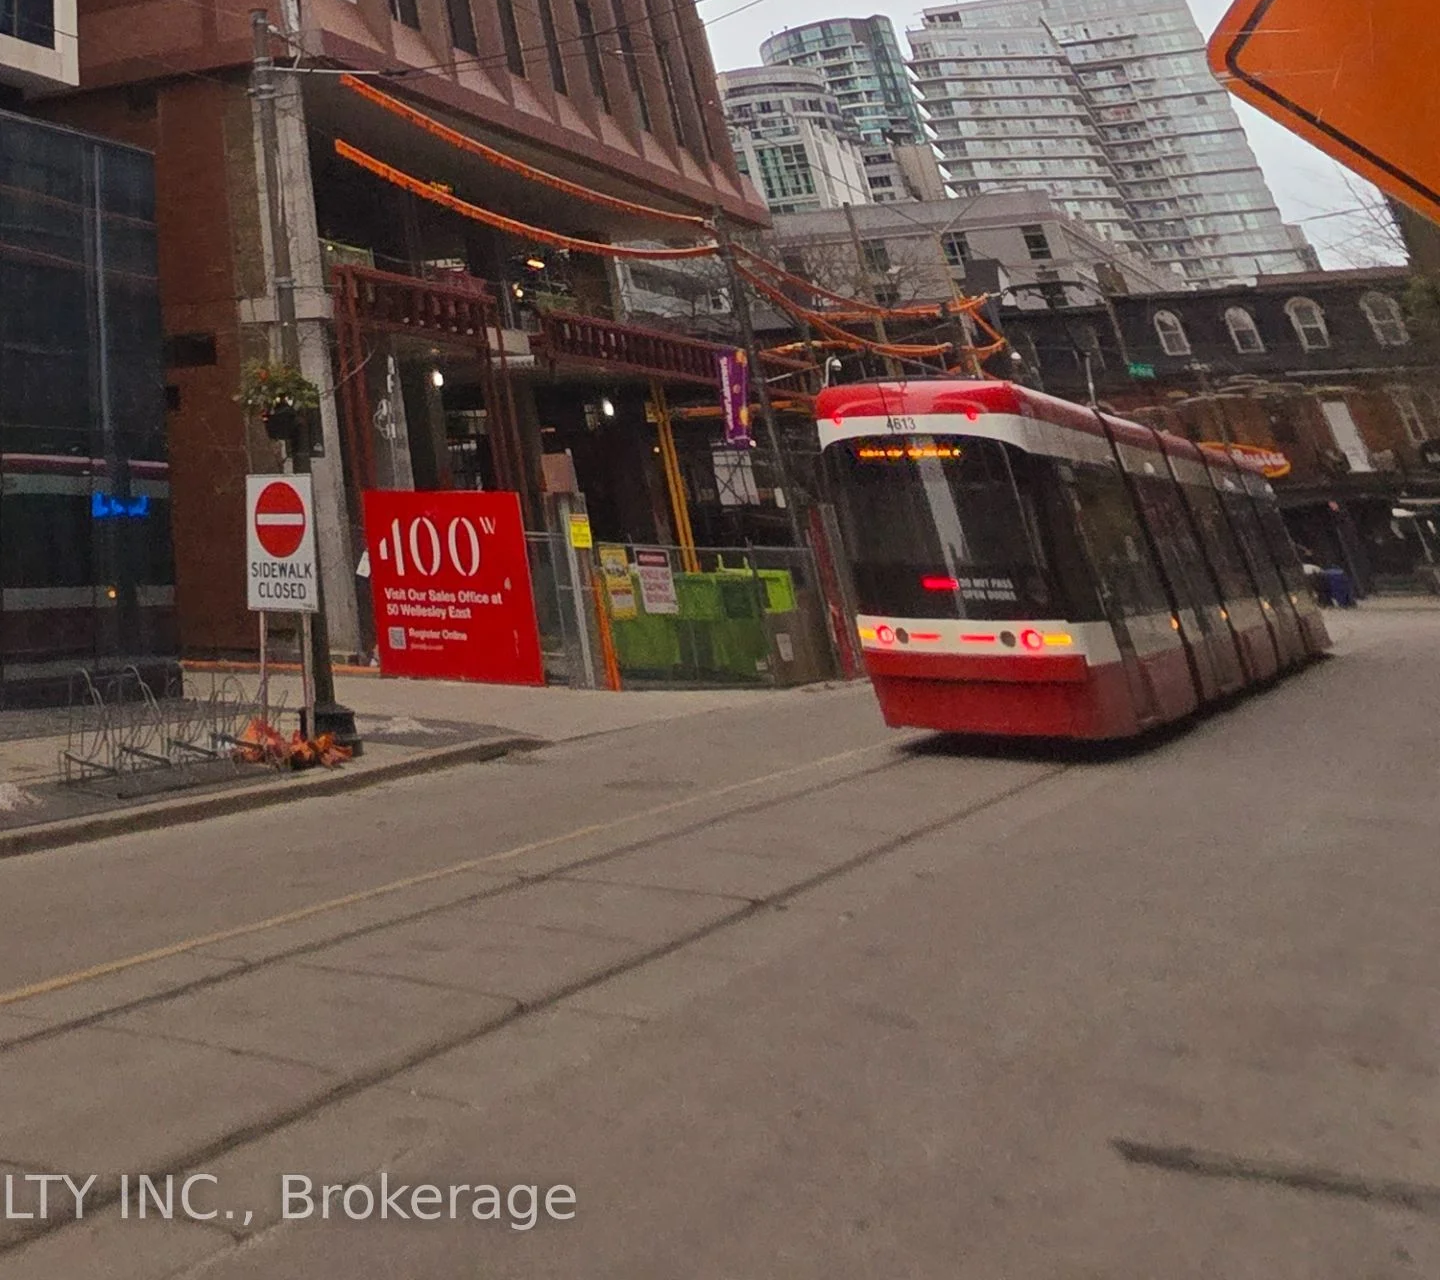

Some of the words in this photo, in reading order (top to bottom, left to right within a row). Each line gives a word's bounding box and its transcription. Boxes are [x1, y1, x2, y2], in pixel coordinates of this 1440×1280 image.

[886, 416, 917, 431] 4613
[251, 562, 313, 578] SIDEWALK
[258, 582, 307, 599] CLOSED
[384, 587, 406, 600] Visit
[408, 588, 427, 601] Our
[428, 590, 456, 603] Sales
[458, 591, 490, 604] Office
[490, 592, 503, 605] at
[387, 606, 399, 616] 50
[400, 606, 447, 620] Wellesley
[448, 606, 472, 619] East
